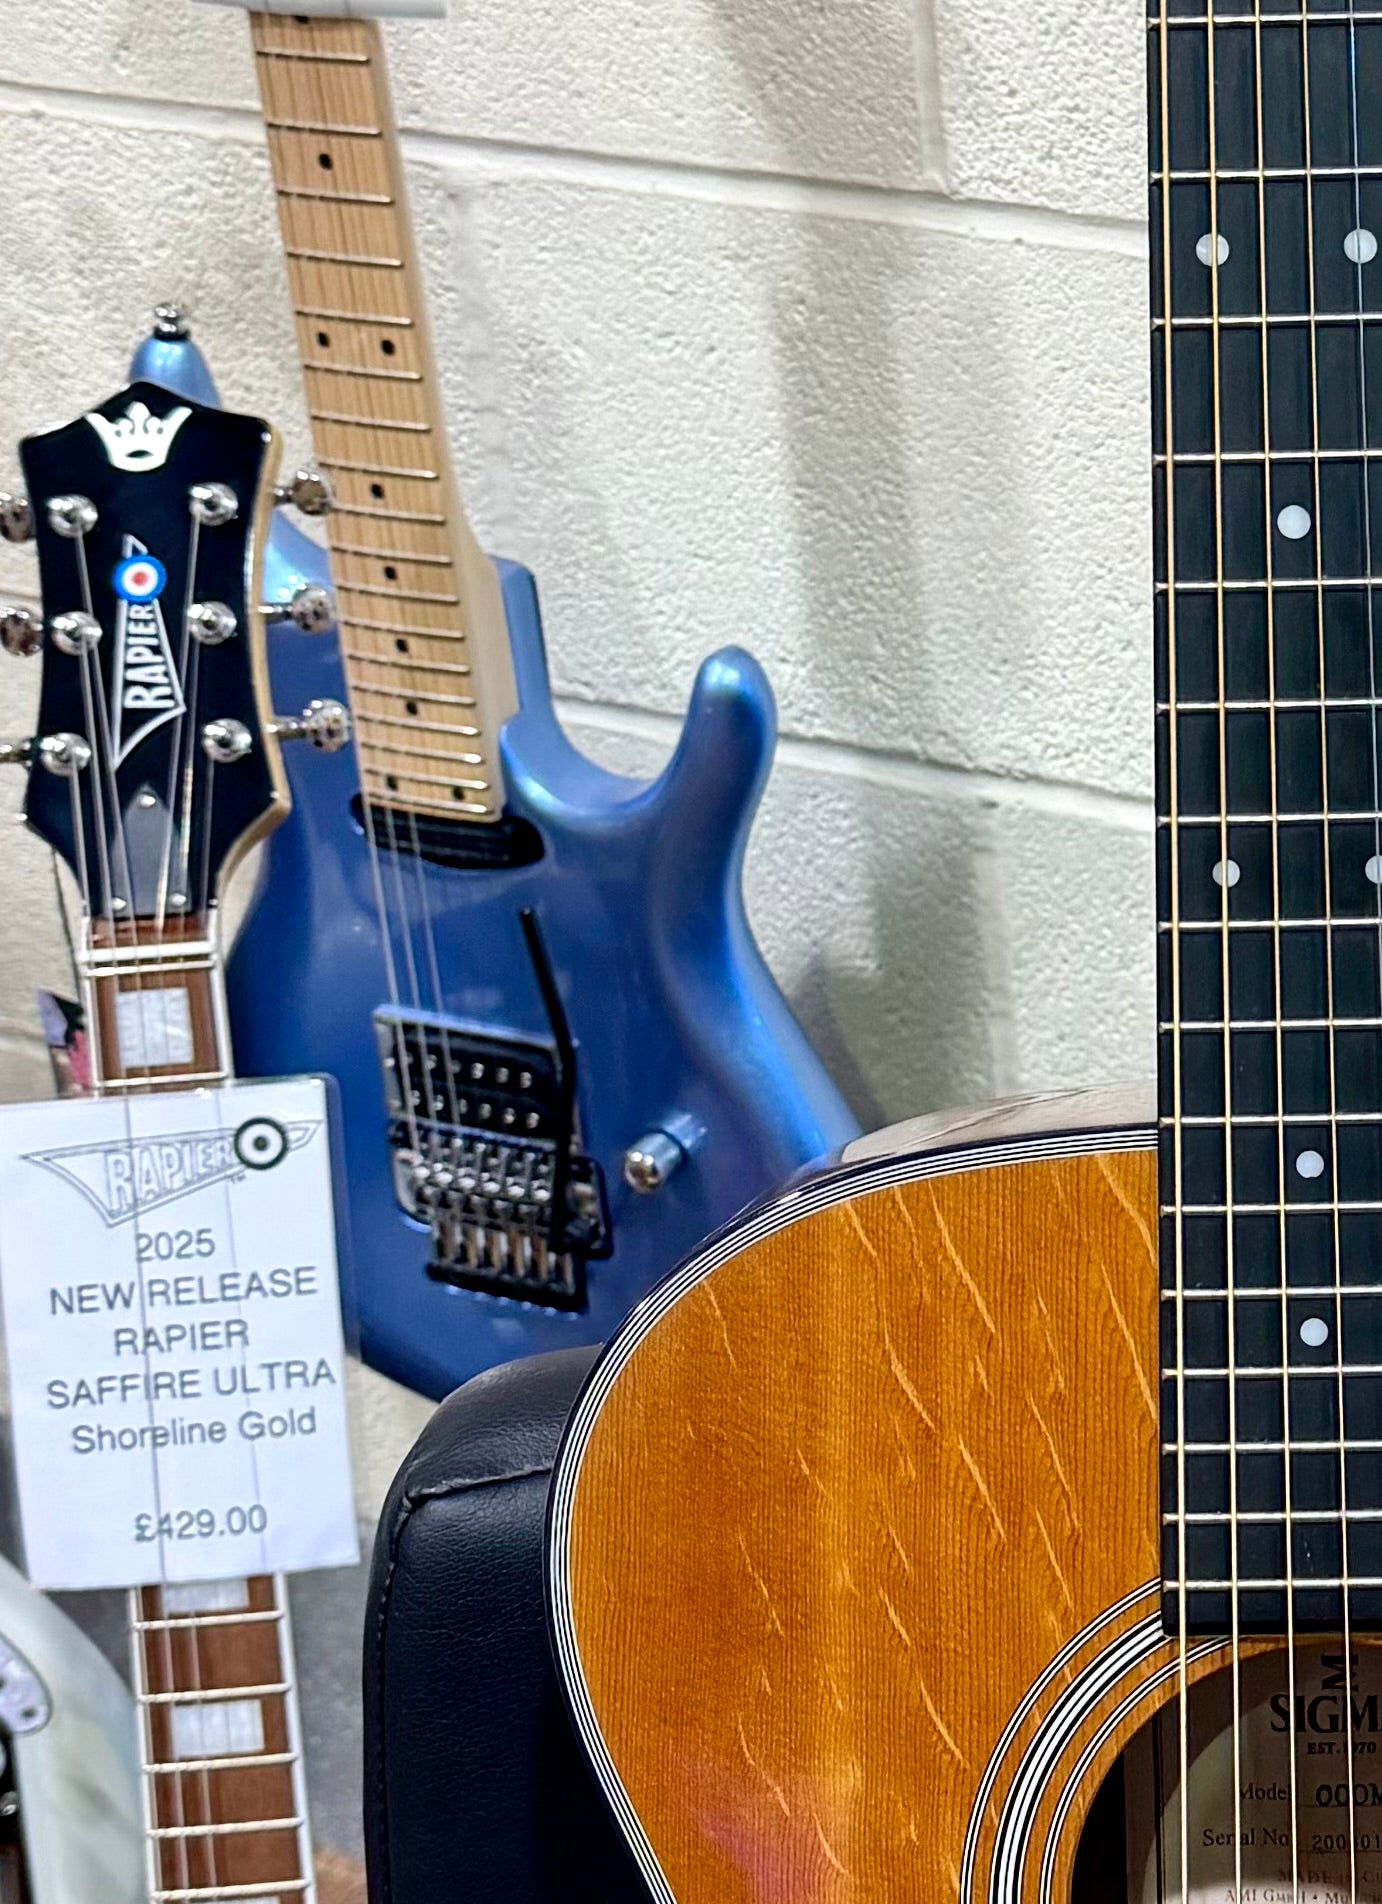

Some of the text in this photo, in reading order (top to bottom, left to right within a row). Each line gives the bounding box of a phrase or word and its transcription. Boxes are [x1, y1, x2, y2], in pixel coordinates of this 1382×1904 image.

[122, 603, 176, 709] RAPIER
[104, 1136, 237, 1215] RAPIER
[136, 1228, 216, 1263] 2025
[50, 1266, 319, 1315] NEW RELEASE
[114, 1319, 250, 1356] RAPIER
[47, 1358, 337, 1410] SAFFIRE ULTRA
[72, 1406, 317, 1455] Shoreline Gold
[134, 1504, 268, 1542] £429.00
[1203, 1827, 1255, 1847] Seral
